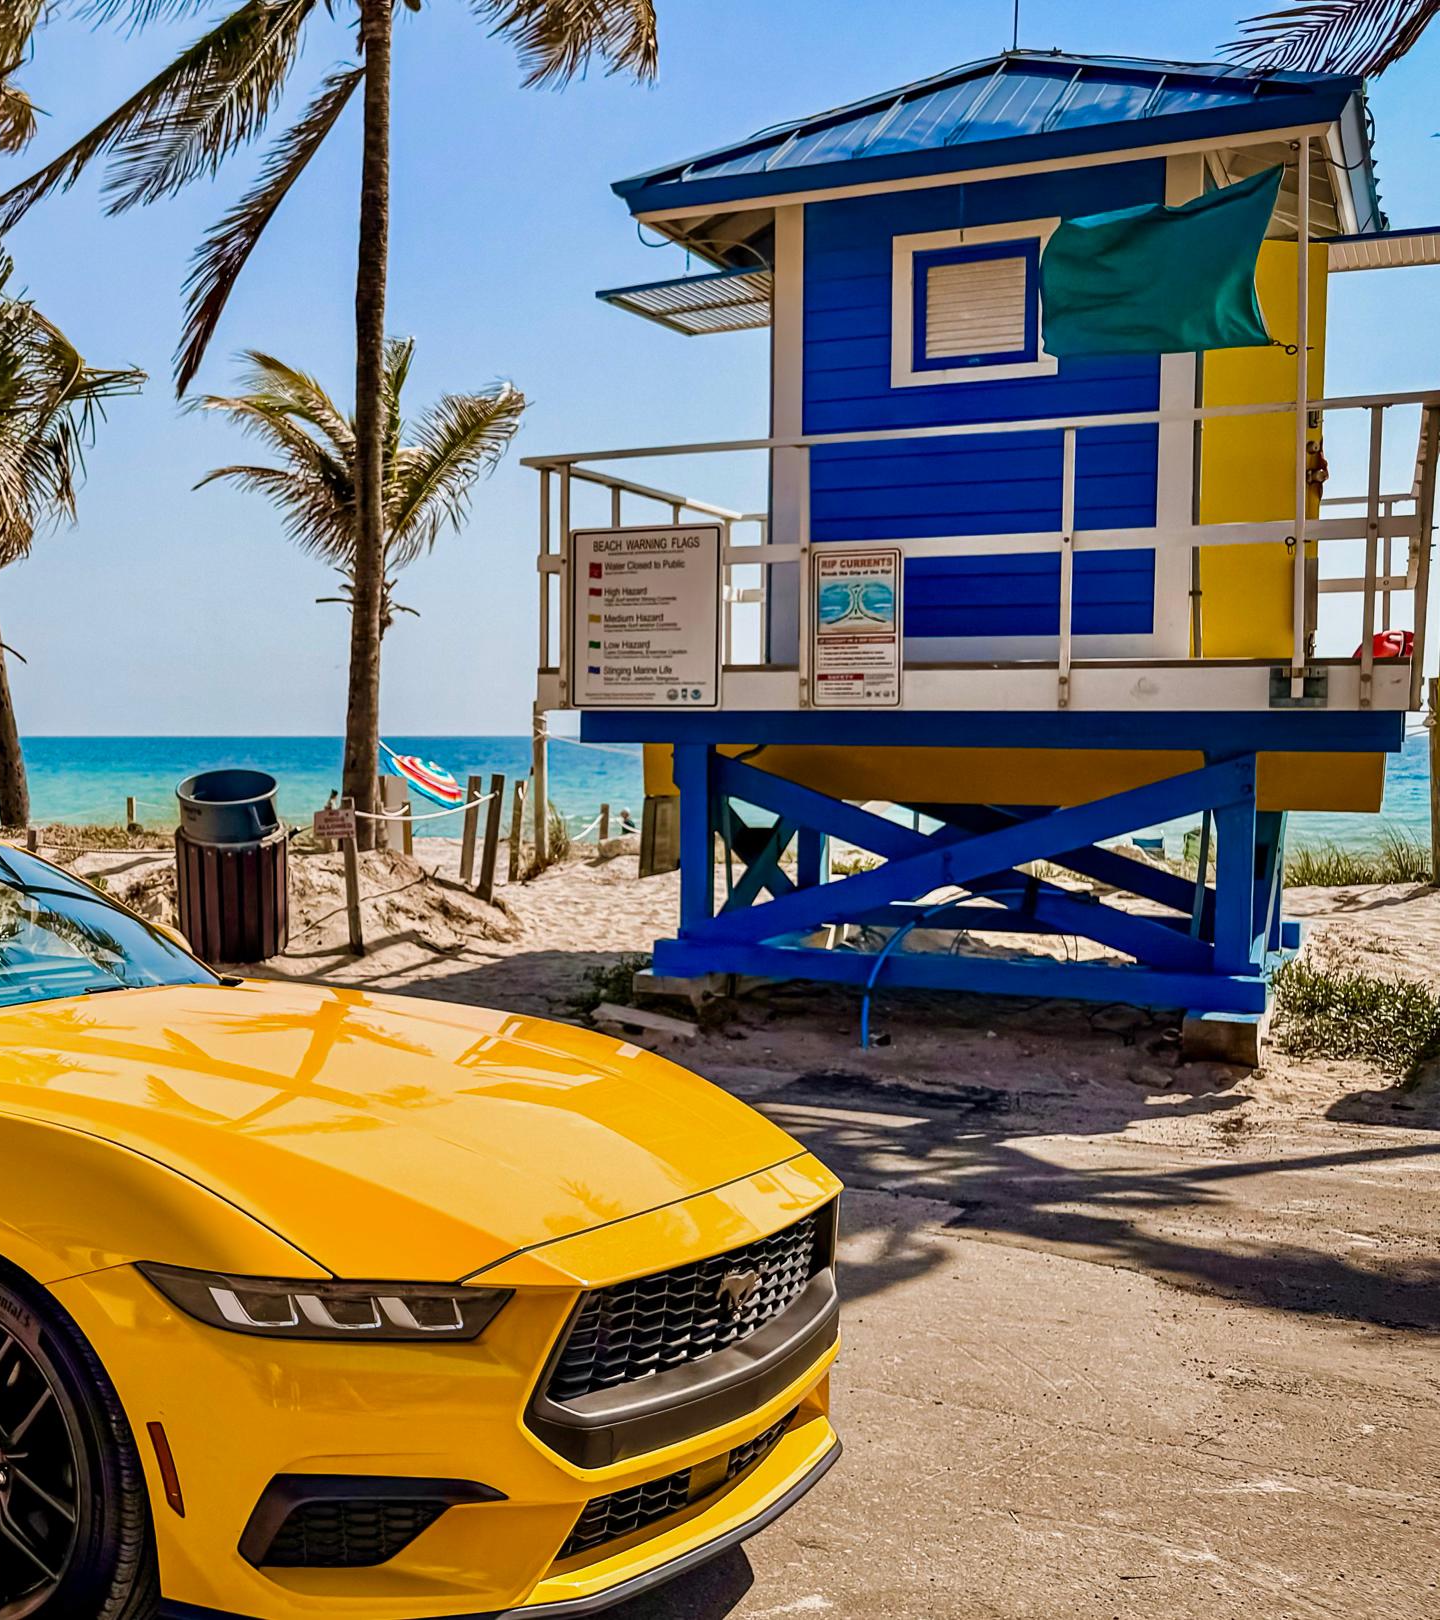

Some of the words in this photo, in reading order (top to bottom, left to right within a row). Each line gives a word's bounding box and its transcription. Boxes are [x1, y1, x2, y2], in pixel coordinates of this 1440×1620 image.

[592, 540, 623, 552] BEACH
[626, 538, 667, 551] WARNING
[671, 536, 701, 549] FLAGS
[604, 561, 626, 570] Water
[626, 560, 652, 570] Closed
[653, 560, 662, 569] to
[662, 559, 686, 569] Public
[820, 559, 838, 569] RIP
[839, 557, 893, 569] CURRENTS
[604, 587, 621, 598] High
[622, 587, 648, 596] Hazard
[604, 614, 634, 623] Medium
[635, 613, 664, 622] Hazard
[604, 640, 620, 649] Low
[621, 640, 651, 649] Hazard
[603, 665, 632, 677] Stinging
[632, 665, 658, 674] Marine
[658, 665, 673, 674] Life
